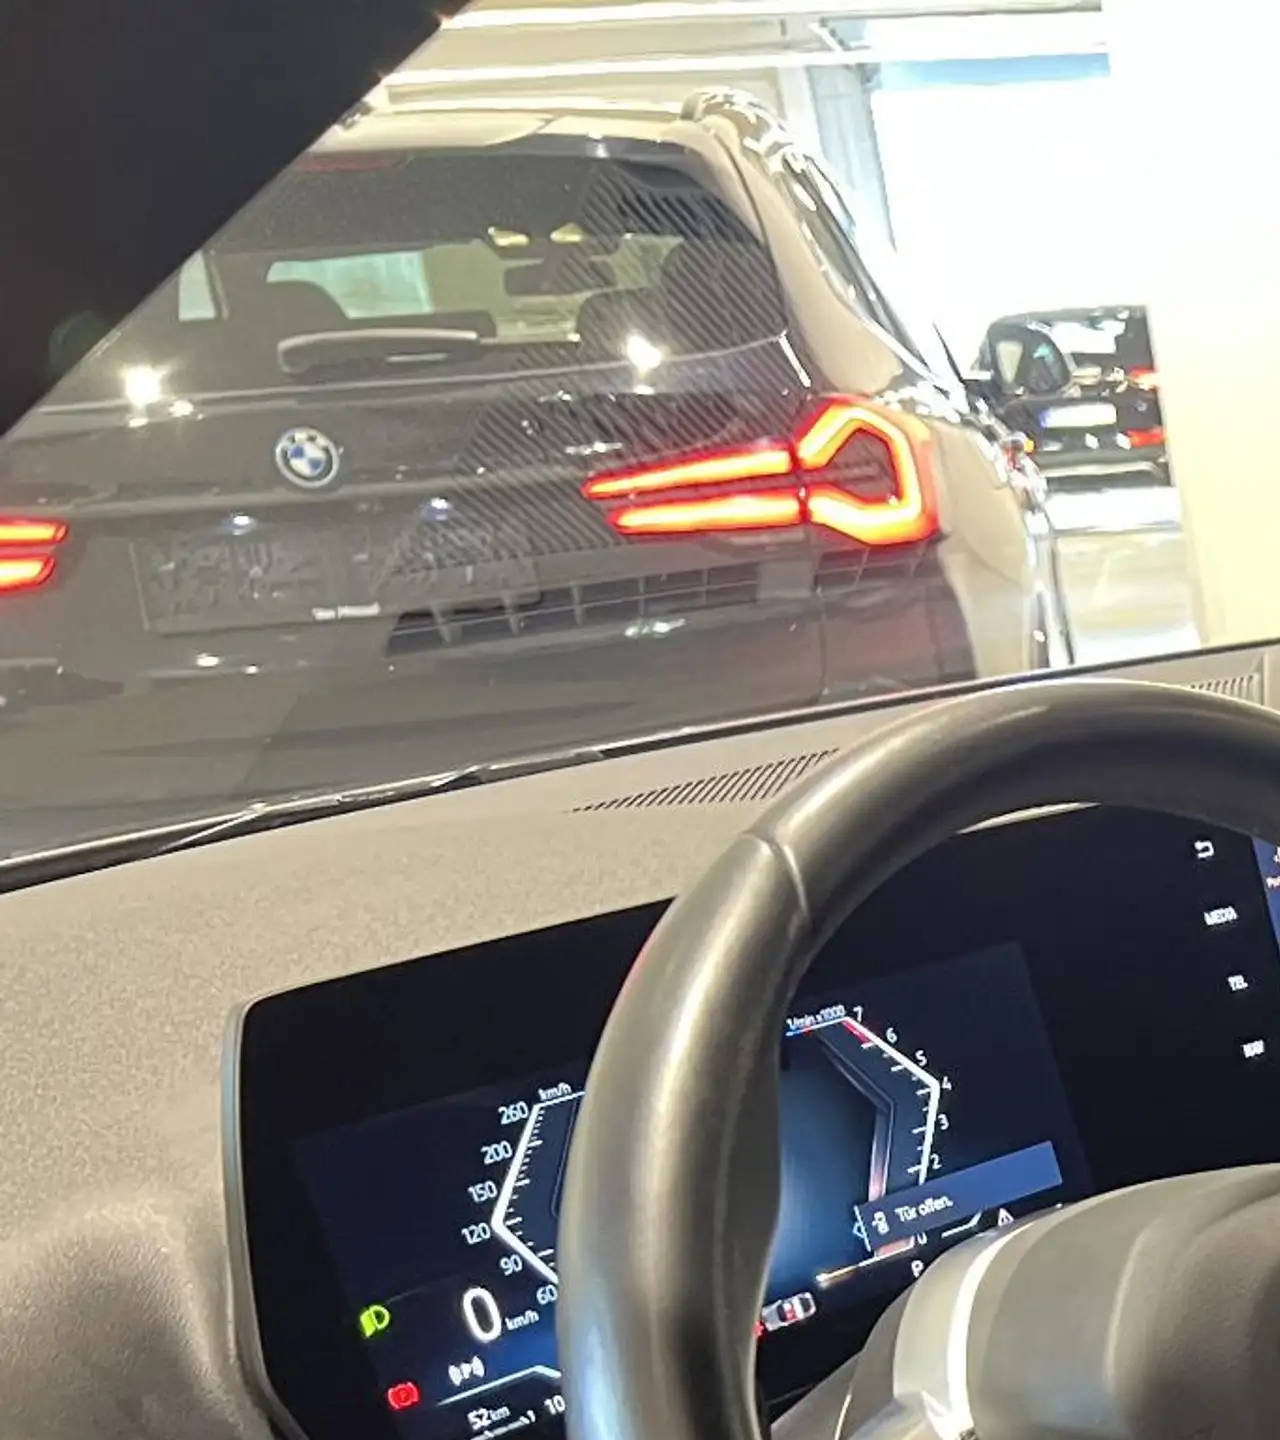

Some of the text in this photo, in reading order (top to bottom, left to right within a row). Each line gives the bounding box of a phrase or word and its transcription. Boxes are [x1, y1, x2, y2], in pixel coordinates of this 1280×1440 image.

[853, 1005, 864, 1022] 7
[886, 1027, 898, 1043] 6
[915, 1050, 927, 1066] 5
[538, 1082, 573, 1101] km/h
[942, 1076, 953, 1091] 4
[498, 1101, 529, 1125] 260
[937, 1114, 950, 1130] 3
[481, 1140, 513, 1165] 200
[930, 1154, 943, 1170] 2
[467, 1180, 498, 1203] 150
[894, 1205, 918, 1222] Tür
[461, 1222, 491, 1245] 120
[500, 1254, 523, 1276] 90
[911, 1260, 924, 1278] P
[536, 1284, 558, 1305] 60
[462, 1287, 540, 1343] 0 km/h
